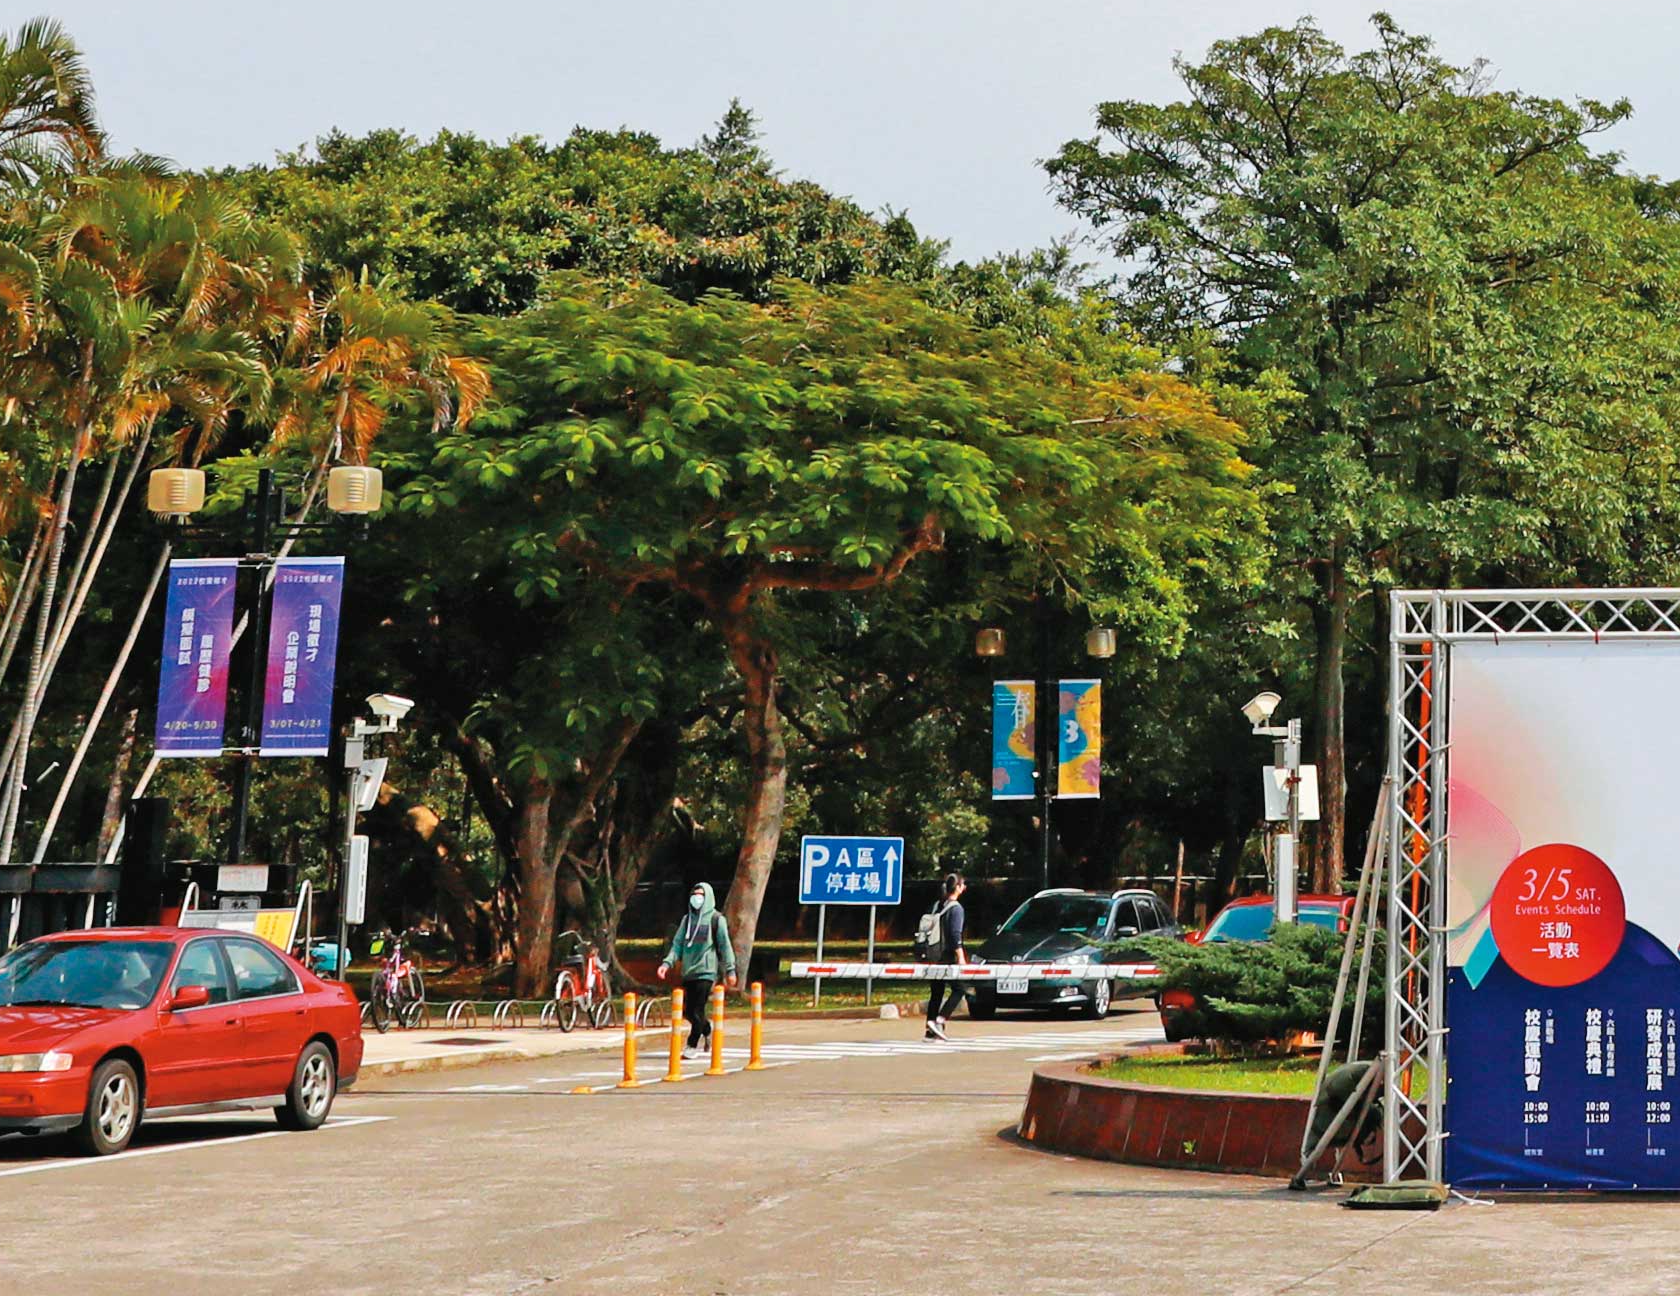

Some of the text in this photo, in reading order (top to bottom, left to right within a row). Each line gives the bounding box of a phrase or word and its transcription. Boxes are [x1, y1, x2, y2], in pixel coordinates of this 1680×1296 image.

[803, 844, 830, 895] P
[825, 872, 880, 894] 停車場
[1517, 867, 1601, 901] 3/5 SAT.
[1515, 904, 1600, 915] Events Schedule
[1540, 922, 1572, 938] 活動
[1532, 943, 1579, 959] 一覽表
[1586, 1008, 1602, 1074] 校慶典禮
[1525, 1008, 1541, 1091] 校慶運動會
[1646, 1009, 1662, 1091] 研發成果展
[1524, 1102, 1548, 1111] 10:00
[1585, 1102, 1609, 1111] 10:00
[1646, 1102, 1670, 1111] 10:00
[1524, 1114, 1548, 1123] 15:00
[1585, 1114, 1609, 1123] 11:10
[1646, 1114, 1670, 1123] 12:00
